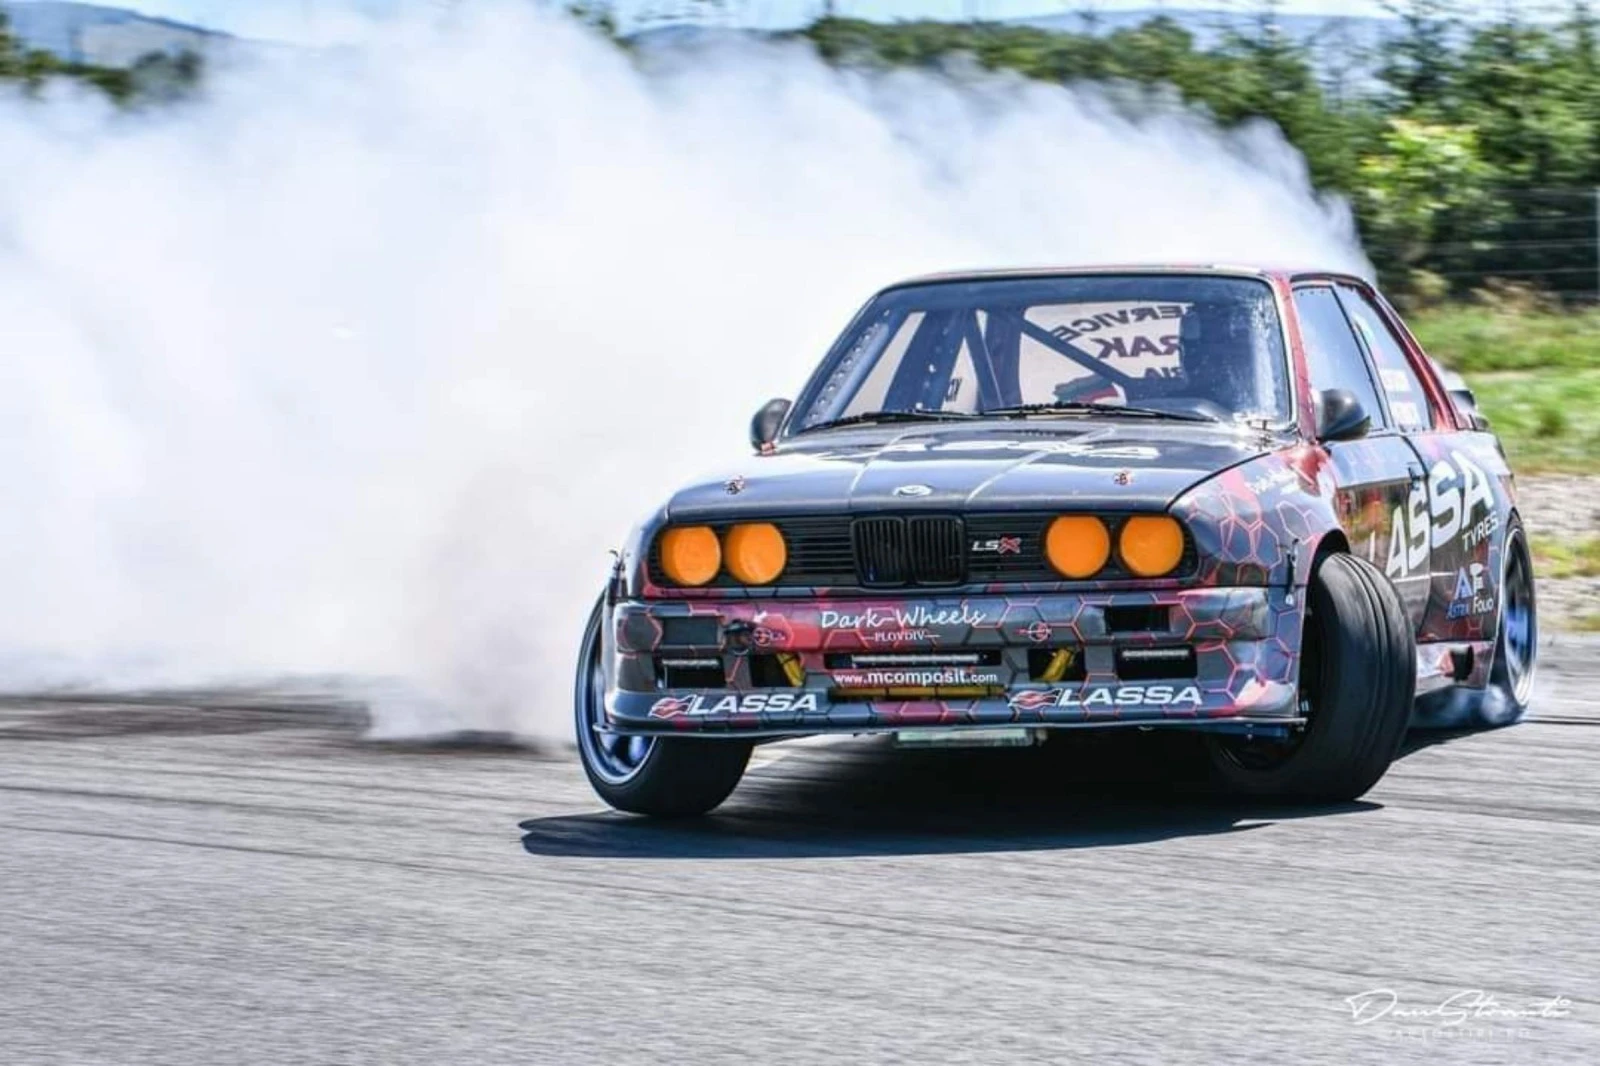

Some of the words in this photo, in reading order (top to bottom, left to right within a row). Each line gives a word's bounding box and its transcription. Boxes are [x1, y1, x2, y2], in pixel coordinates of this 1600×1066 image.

[1462, 511, 1499, 552] TYRES
[971, 536, 1022, 554] LSX
[833, 668, 998, 687] www.mcomposit.com
[688, 693, 818, 715] LASSA
[1058, 685, 1204, 707] LASSA
